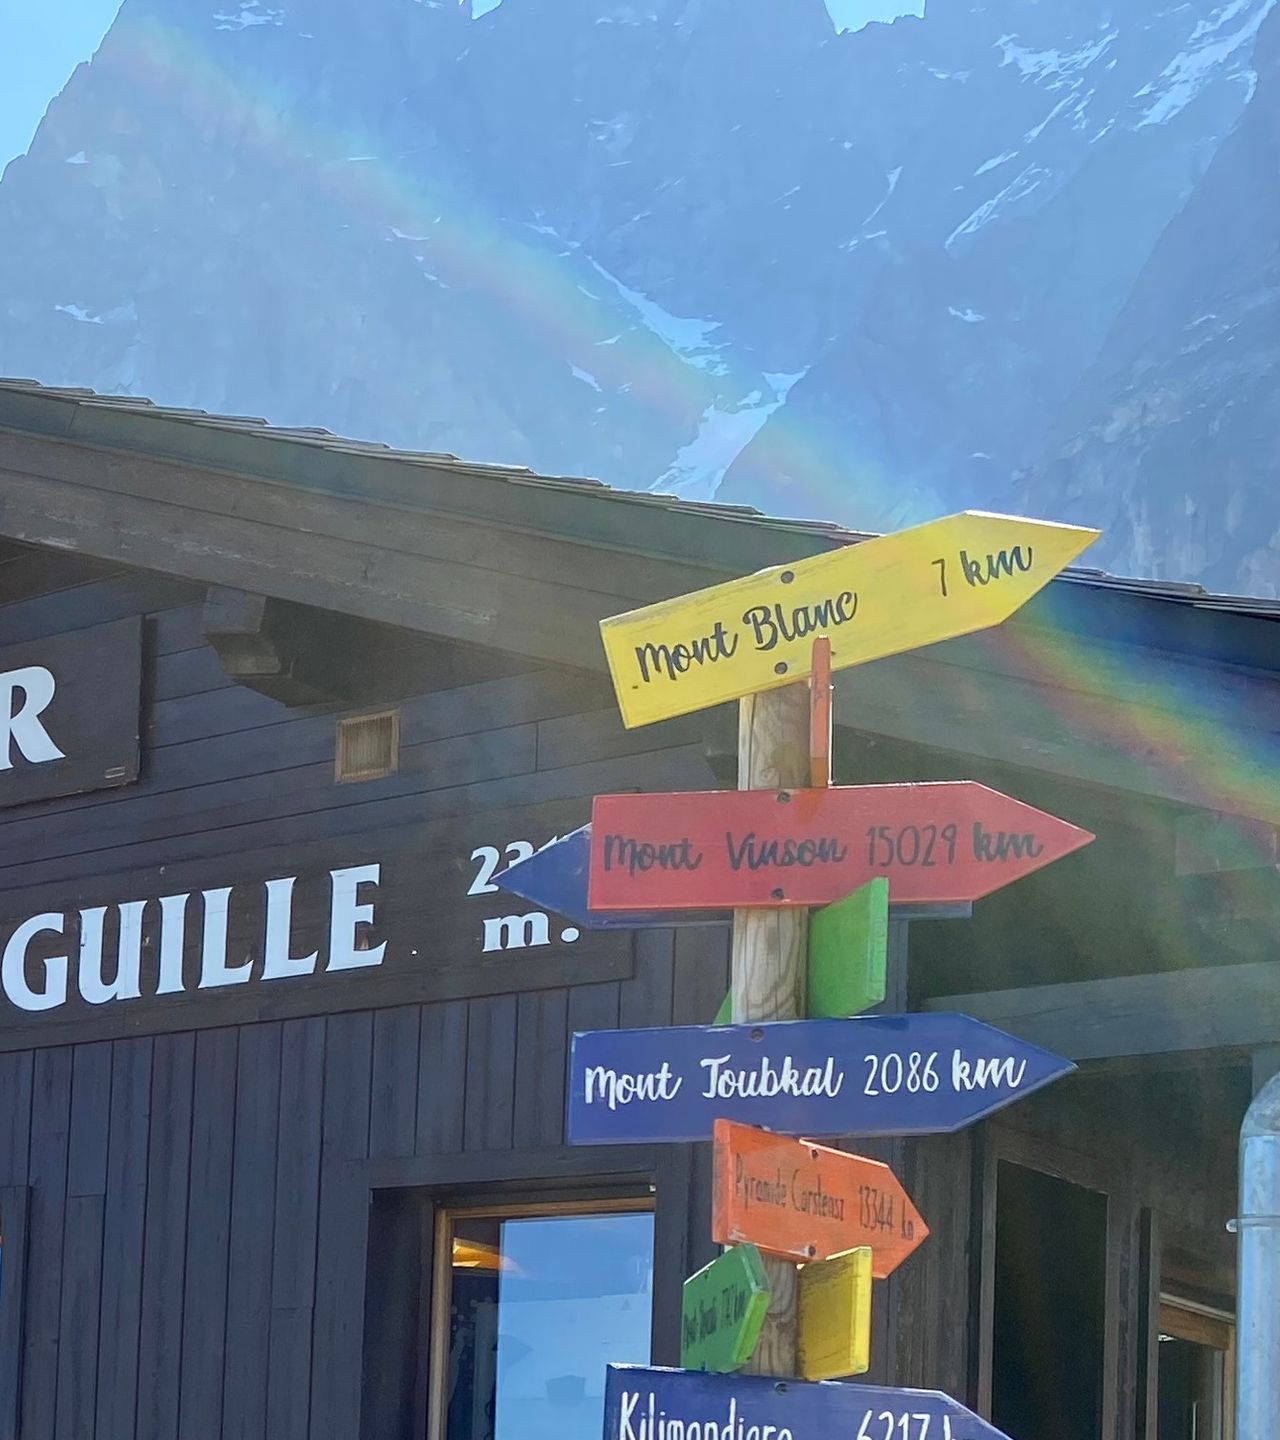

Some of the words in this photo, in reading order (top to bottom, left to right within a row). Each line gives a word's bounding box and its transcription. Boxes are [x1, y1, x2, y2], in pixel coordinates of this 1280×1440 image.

[634, 621, 739, 683] Mont
[742, 591, 858, 651] Blanc
[931, 558, 948, 597] 7
[959, 545, 1033, 587] km
[603, 835, 703, 875] Mont
[725, 832, 847, 872] Vinson
[865, 824, 957, 868] 15029
[972, 822, 1044, 862] km
[482, 911, 580, 953] m.
[585, 1062, 683, 1111] Mont
[700, 1054, 844, 1099] Toubkal
[863, 1051, 939, 1096] 2086
[952, 1049, 1027, 1092] km
